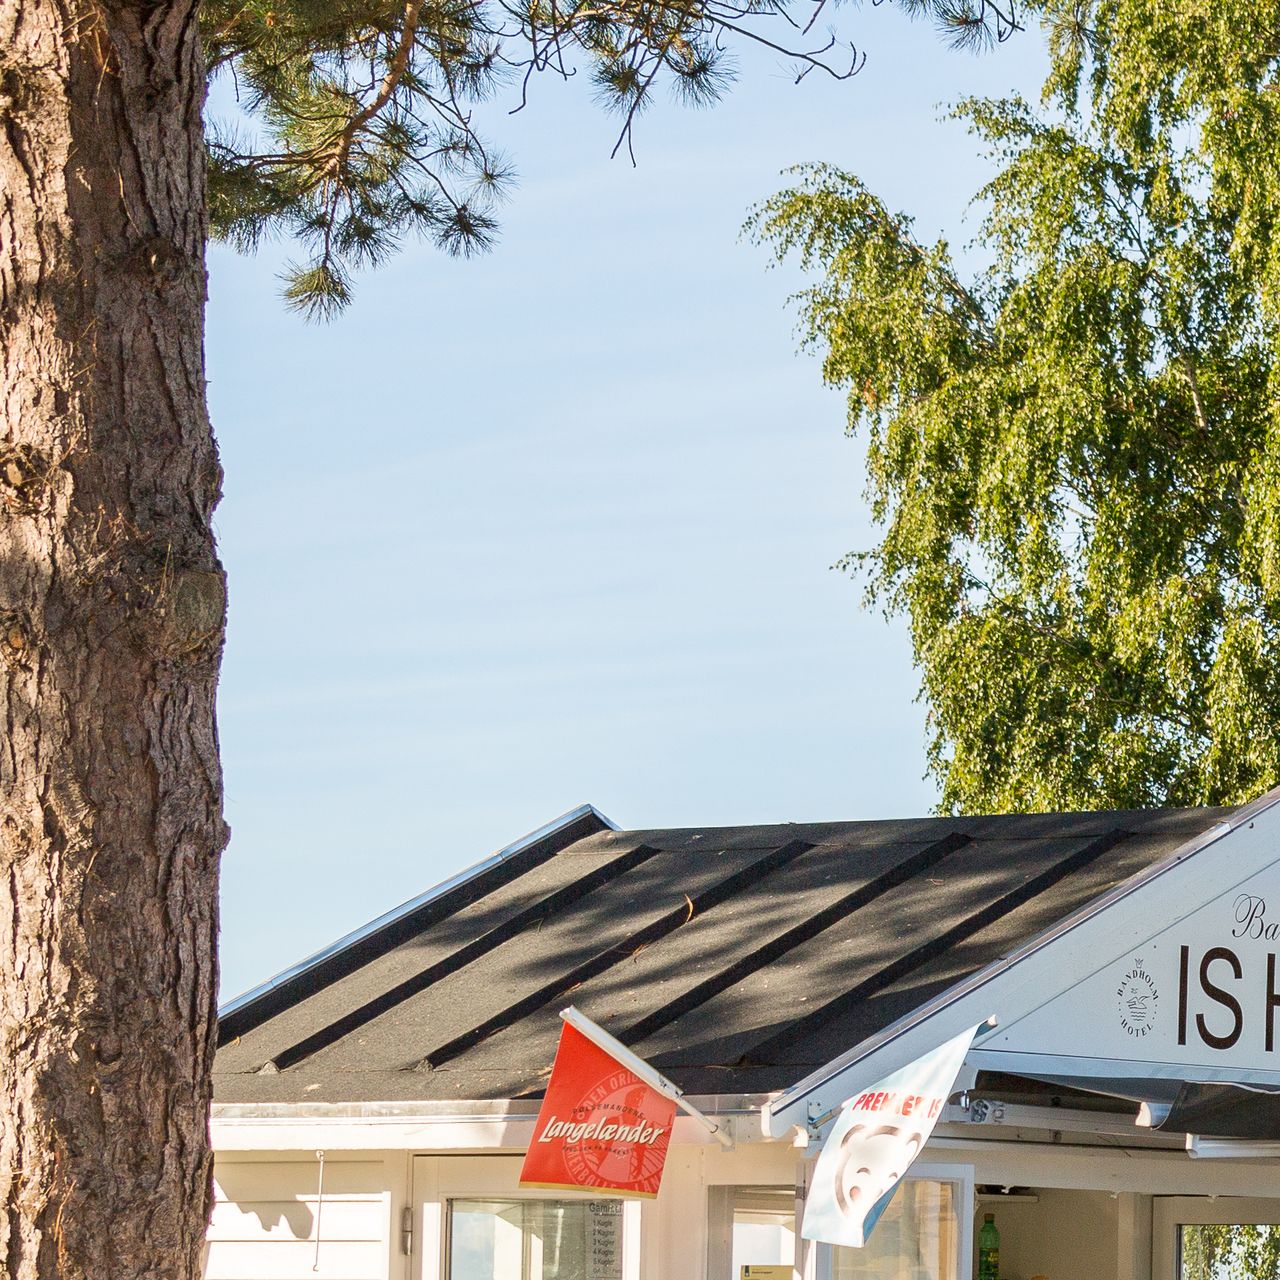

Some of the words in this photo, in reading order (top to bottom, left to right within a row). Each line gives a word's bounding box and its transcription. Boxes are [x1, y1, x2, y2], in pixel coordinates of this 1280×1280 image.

[1117, 969, 1159, 1001] BANDHOLM
[1120, 1018, 1154, 1038] HOTEL
[852, 1092, 925, 1116] PREMER
[537, 1115, 665, 1145] Langelænder
